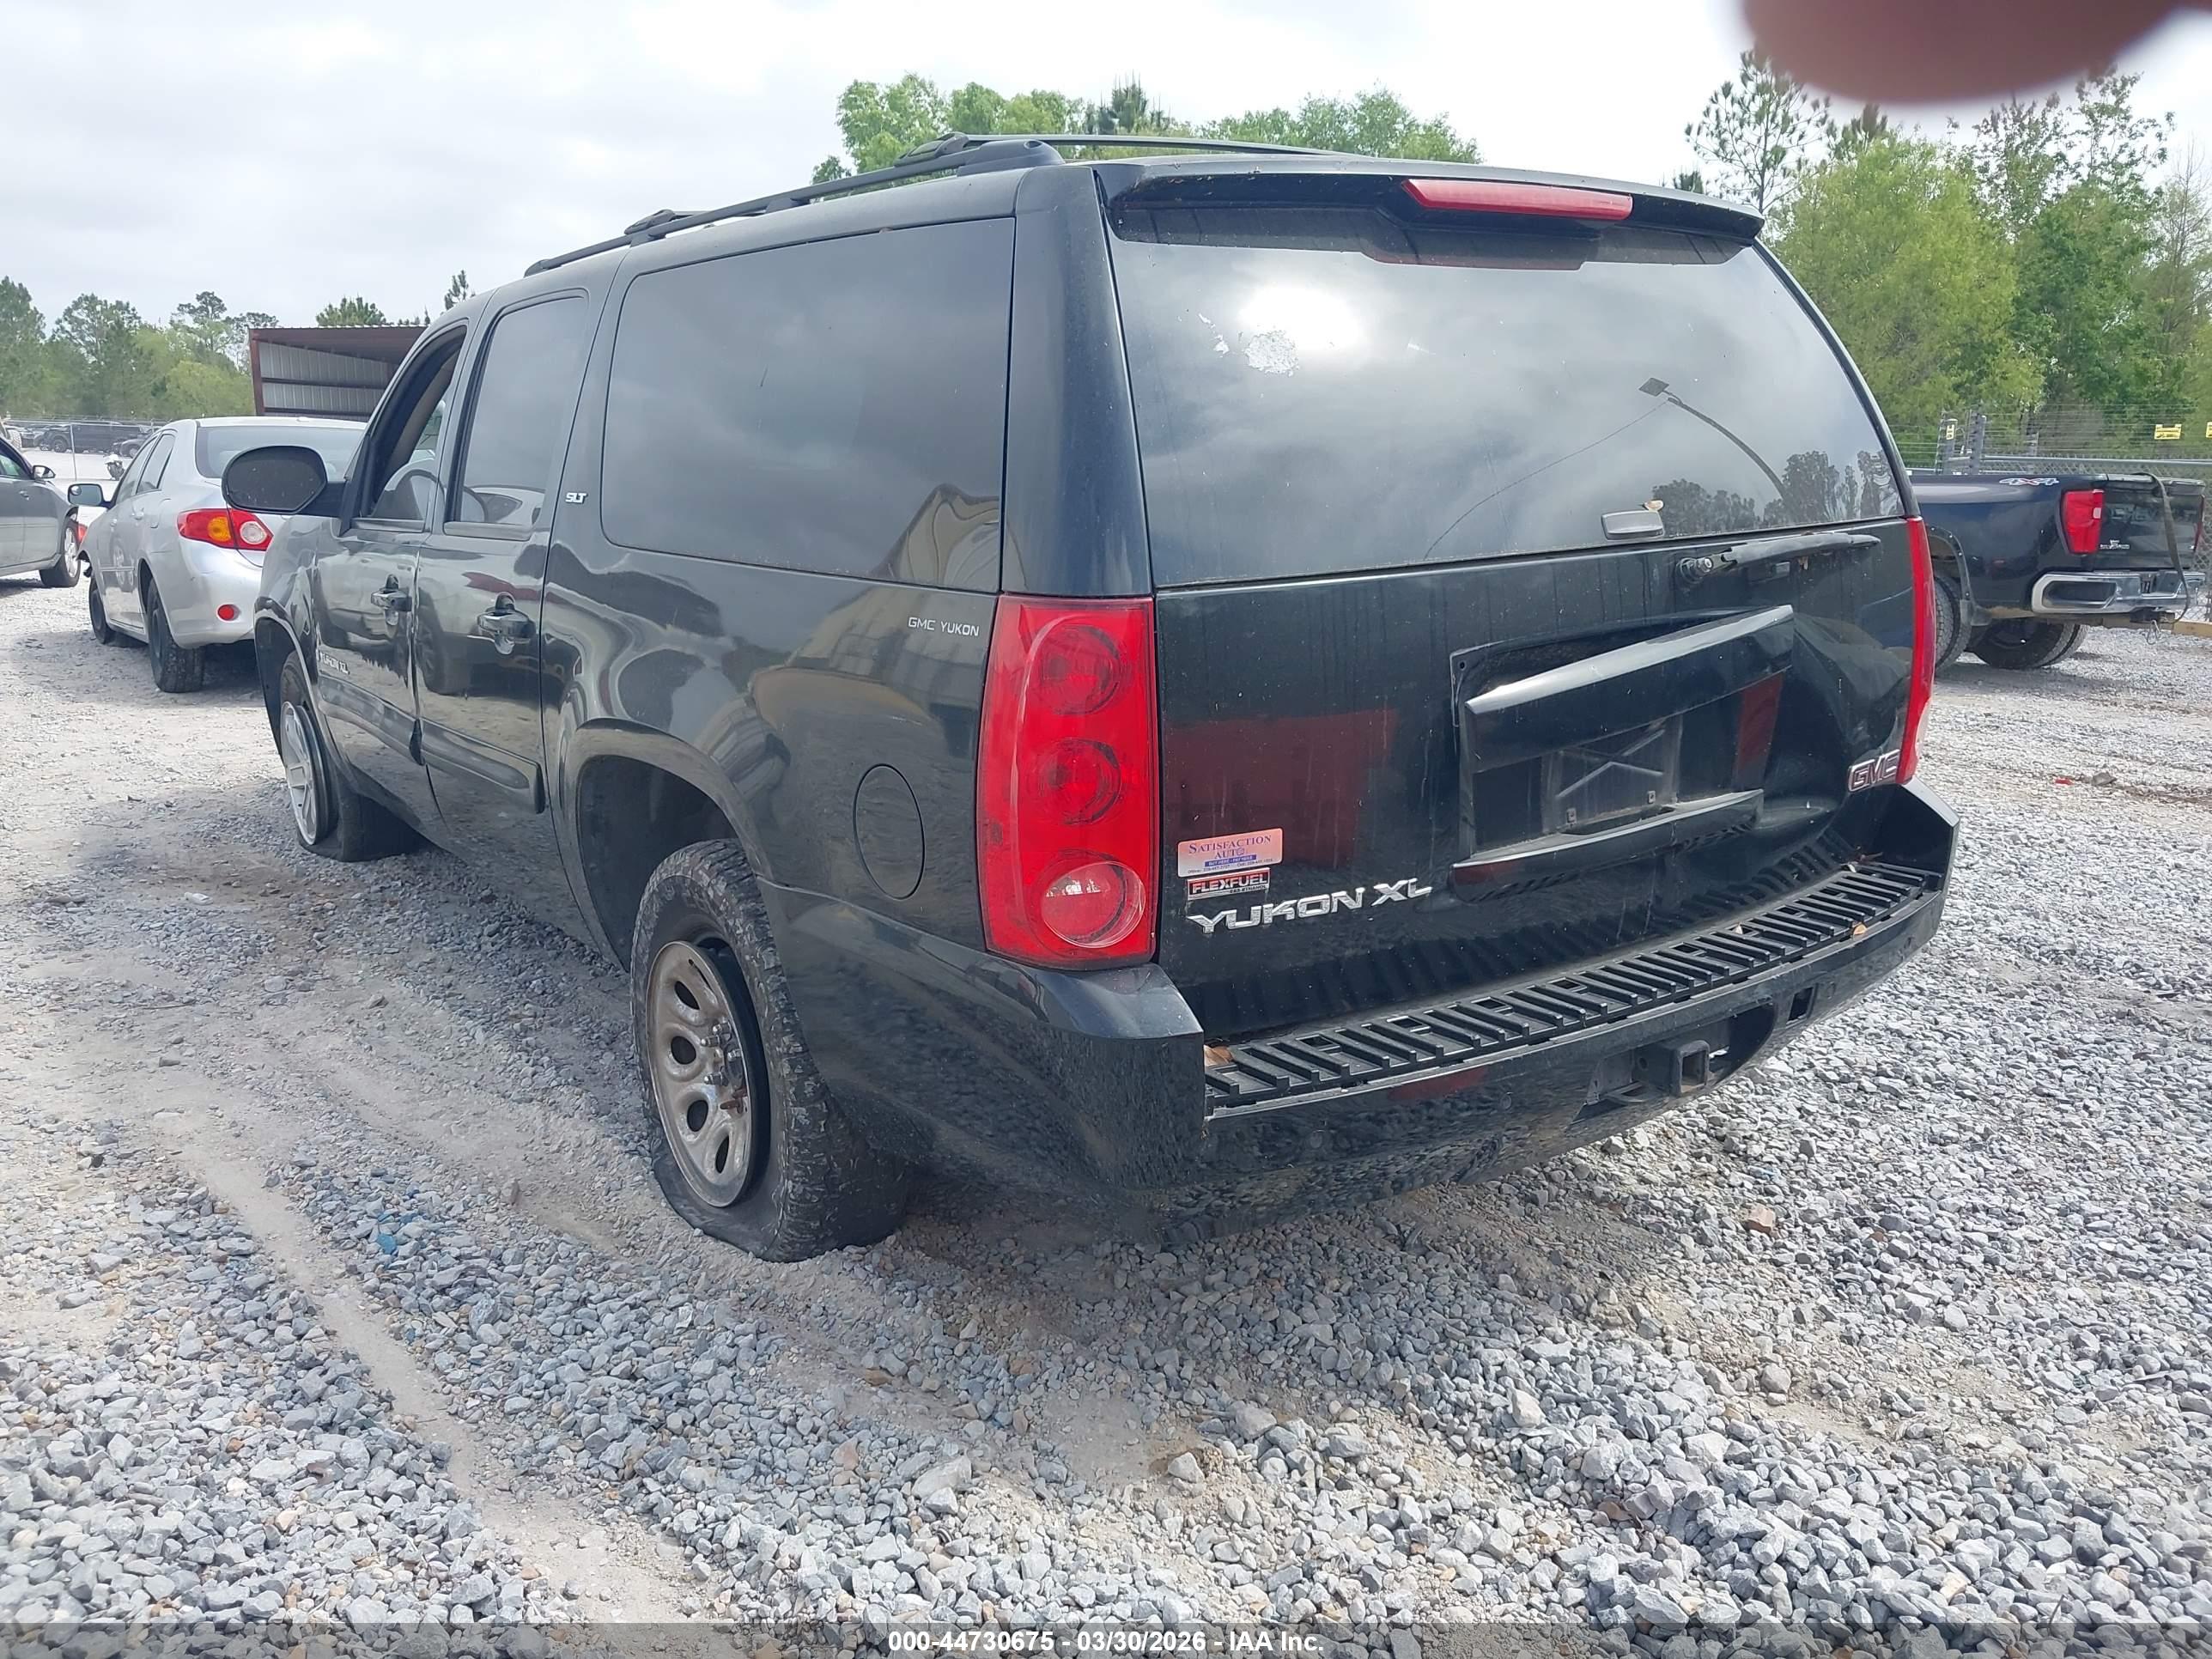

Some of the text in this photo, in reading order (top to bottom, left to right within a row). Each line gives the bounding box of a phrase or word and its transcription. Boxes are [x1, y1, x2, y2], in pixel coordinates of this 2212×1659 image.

[565, 492, 587, 503] SLT
[908, 617, 980, 636] GMC YUKON
[1848, 749, 1900, 792] GMC
[1188, 835, 1272, 854] SATISFACTION
[1214, 848, 1245, 860] AUTO
[1192, 873, 1267, 894] FLEXFUEL
[1186, 878, 1433, 934] YUKON XL
